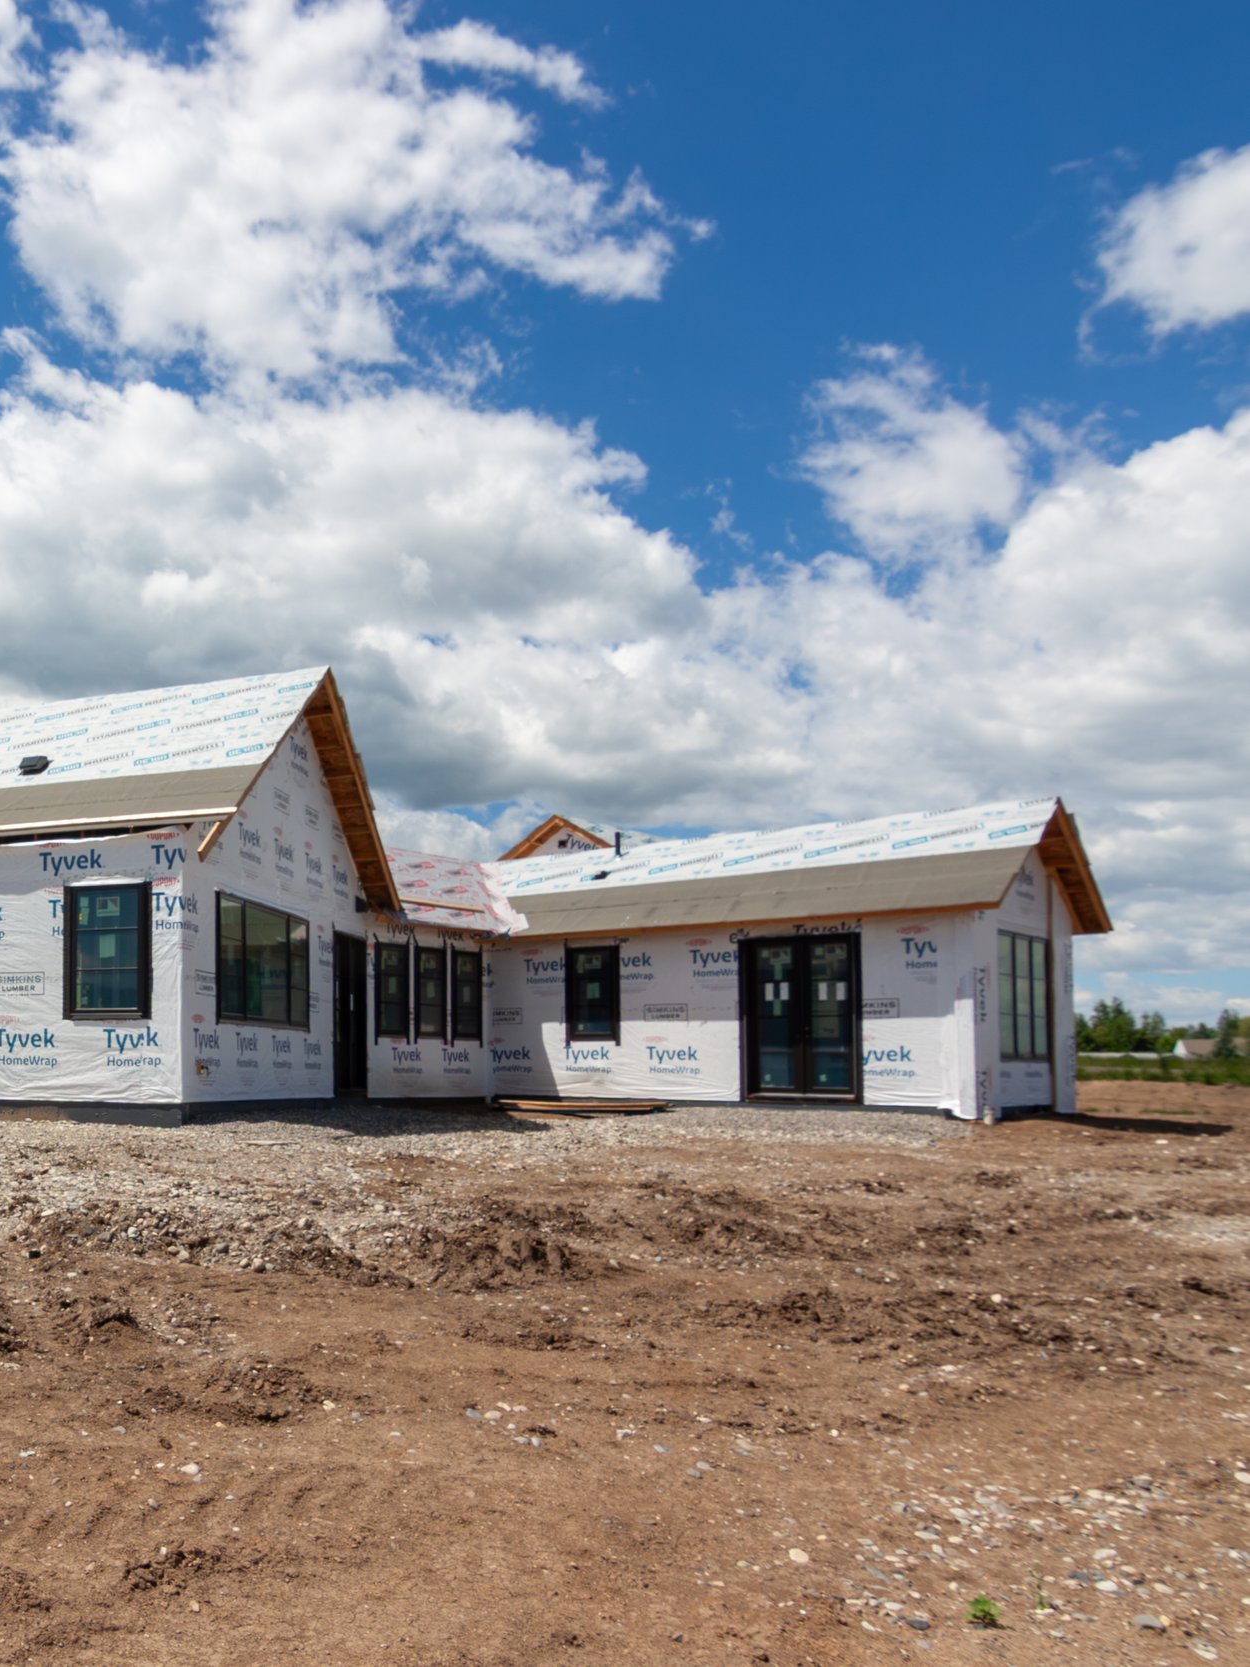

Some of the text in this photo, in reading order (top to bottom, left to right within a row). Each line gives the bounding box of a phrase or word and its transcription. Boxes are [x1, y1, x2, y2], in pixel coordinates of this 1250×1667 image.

[238, 822, 262, 850] Tyvek
[39, 849, 102, 876] Tyvek
[1, 984, 35, 993] LUMBER
[194, 1027, 220, 1054] Tyvek
[235, 1031, 258, 1056] Tyvek
[272, 1034, 291, 1057] Tyvek
[391, 1047, 422, 1066] Tyvek
[442, 1048, 470, 1066] Tyvek
[563, 1045, 609, 1063] Tyvek
[647, 1045, 697, 1063] Tyvek
[650, 1065, 699, 1075] HomeWrap
